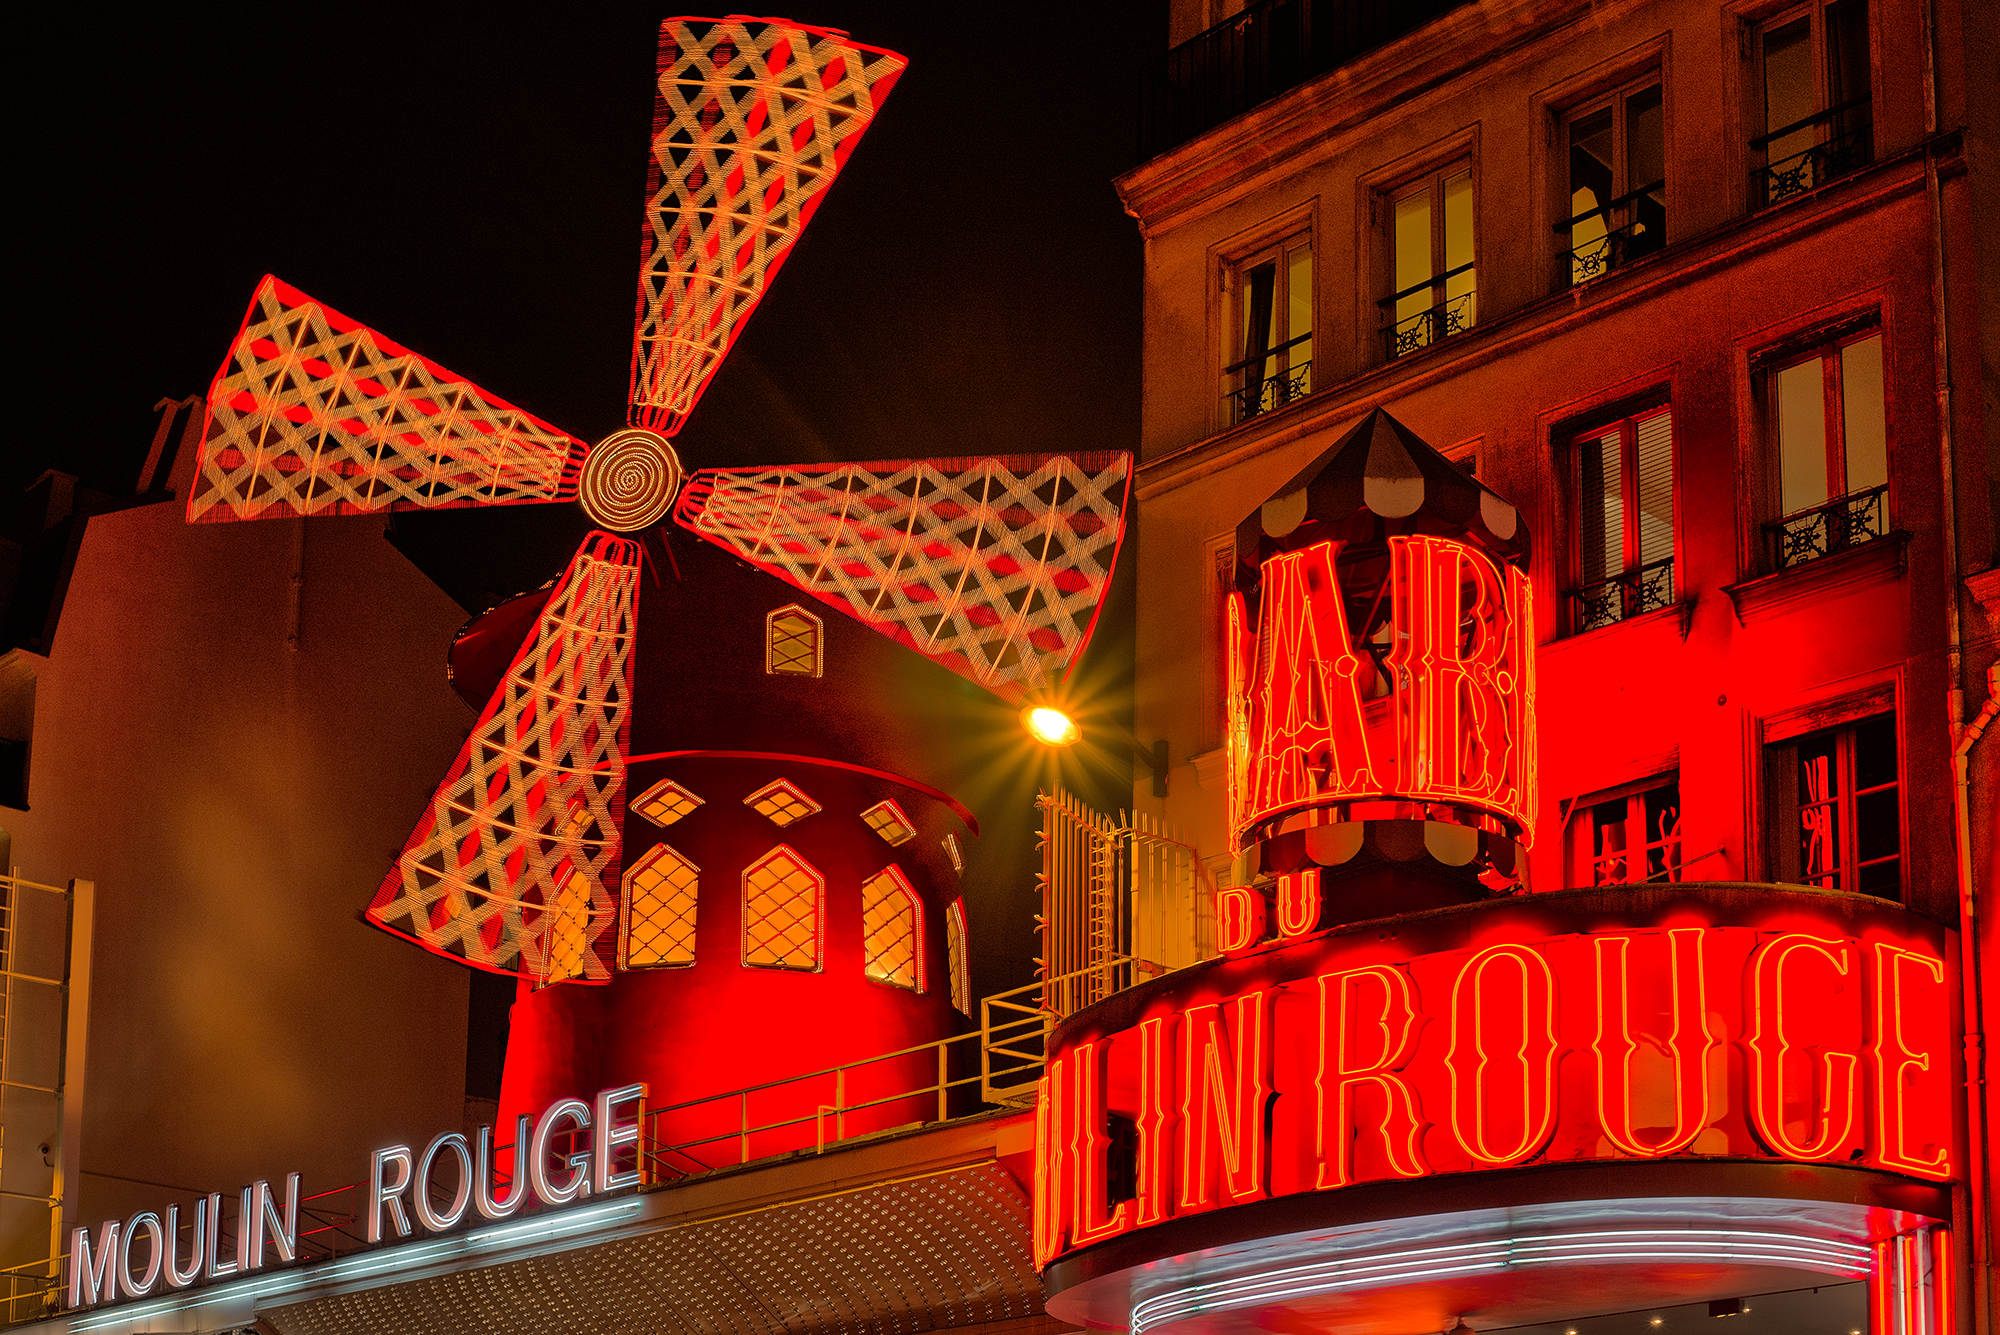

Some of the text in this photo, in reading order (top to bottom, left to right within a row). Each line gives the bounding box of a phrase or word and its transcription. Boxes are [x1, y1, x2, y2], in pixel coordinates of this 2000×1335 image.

[1216, 868, 1323, 952] DU
[66, 1081, 649, 1310] MOULIN ROUGE
[1033, 926, 1951, 1273] ULIN ROUGE
